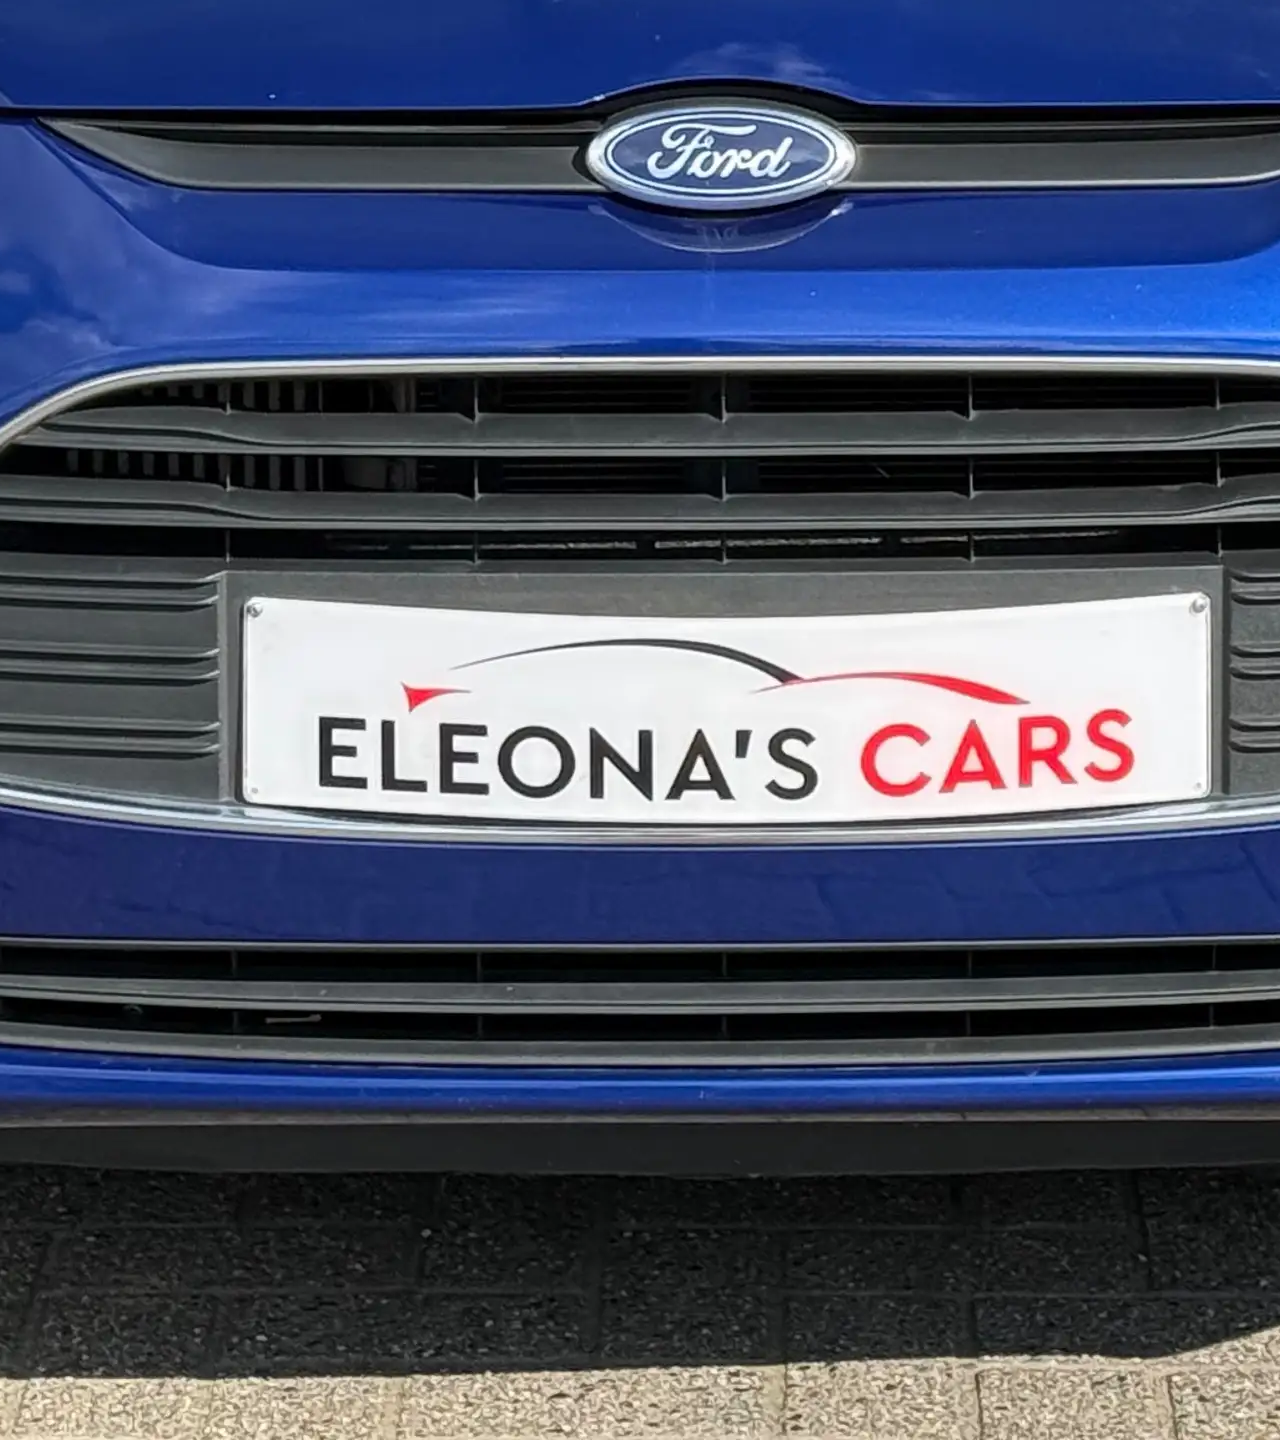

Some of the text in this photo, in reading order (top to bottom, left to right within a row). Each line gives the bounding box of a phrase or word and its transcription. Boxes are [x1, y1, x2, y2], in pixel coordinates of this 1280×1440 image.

[647, 122, 794, 179] Ford
[318, 708, 1136, 801] ELEONA'S CARS
